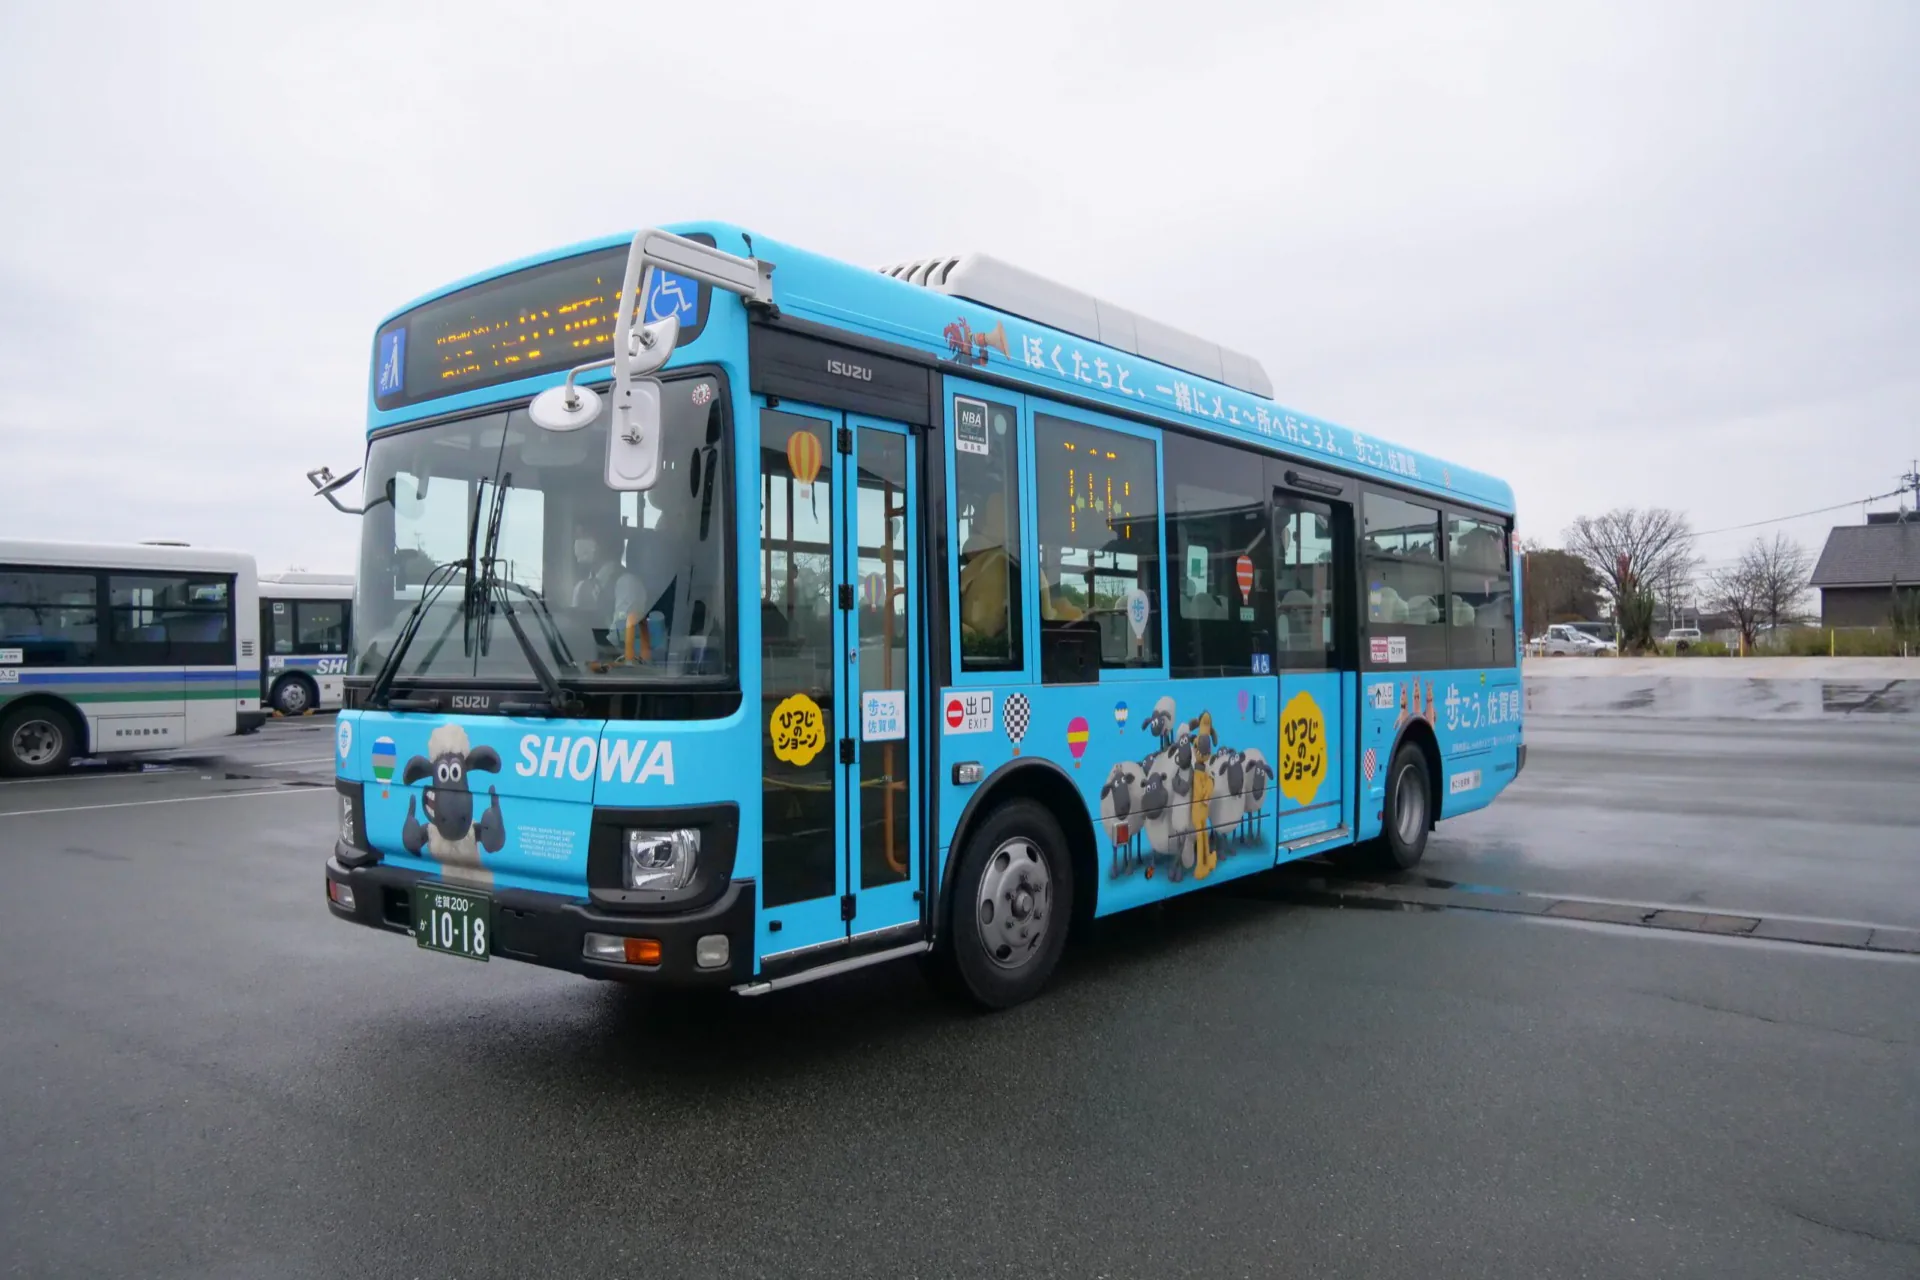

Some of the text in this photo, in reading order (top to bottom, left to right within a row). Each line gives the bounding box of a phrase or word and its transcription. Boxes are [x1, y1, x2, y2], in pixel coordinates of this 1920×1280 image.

[827, 359, 872, 382] ISUZU
[962, 410, 982, 426] NBA
[451, 696, 490, 709] ISUZU
[965, 696, 992, 716] 出口
[779, 710, 816, 729] ひつじ
[968, 718, 988, 730] EXIT
[793, 725, 803, 738] の
[1284, 717, 1319, 748] ひつじ
[778, 732, 818, 751] ショーン
[1298, 741, 1307, 760] の
[515, 733, 675, 786] SHOWA
[1283, 752, 1321, 781] ショーン
[420, 919, 428, 932] か
